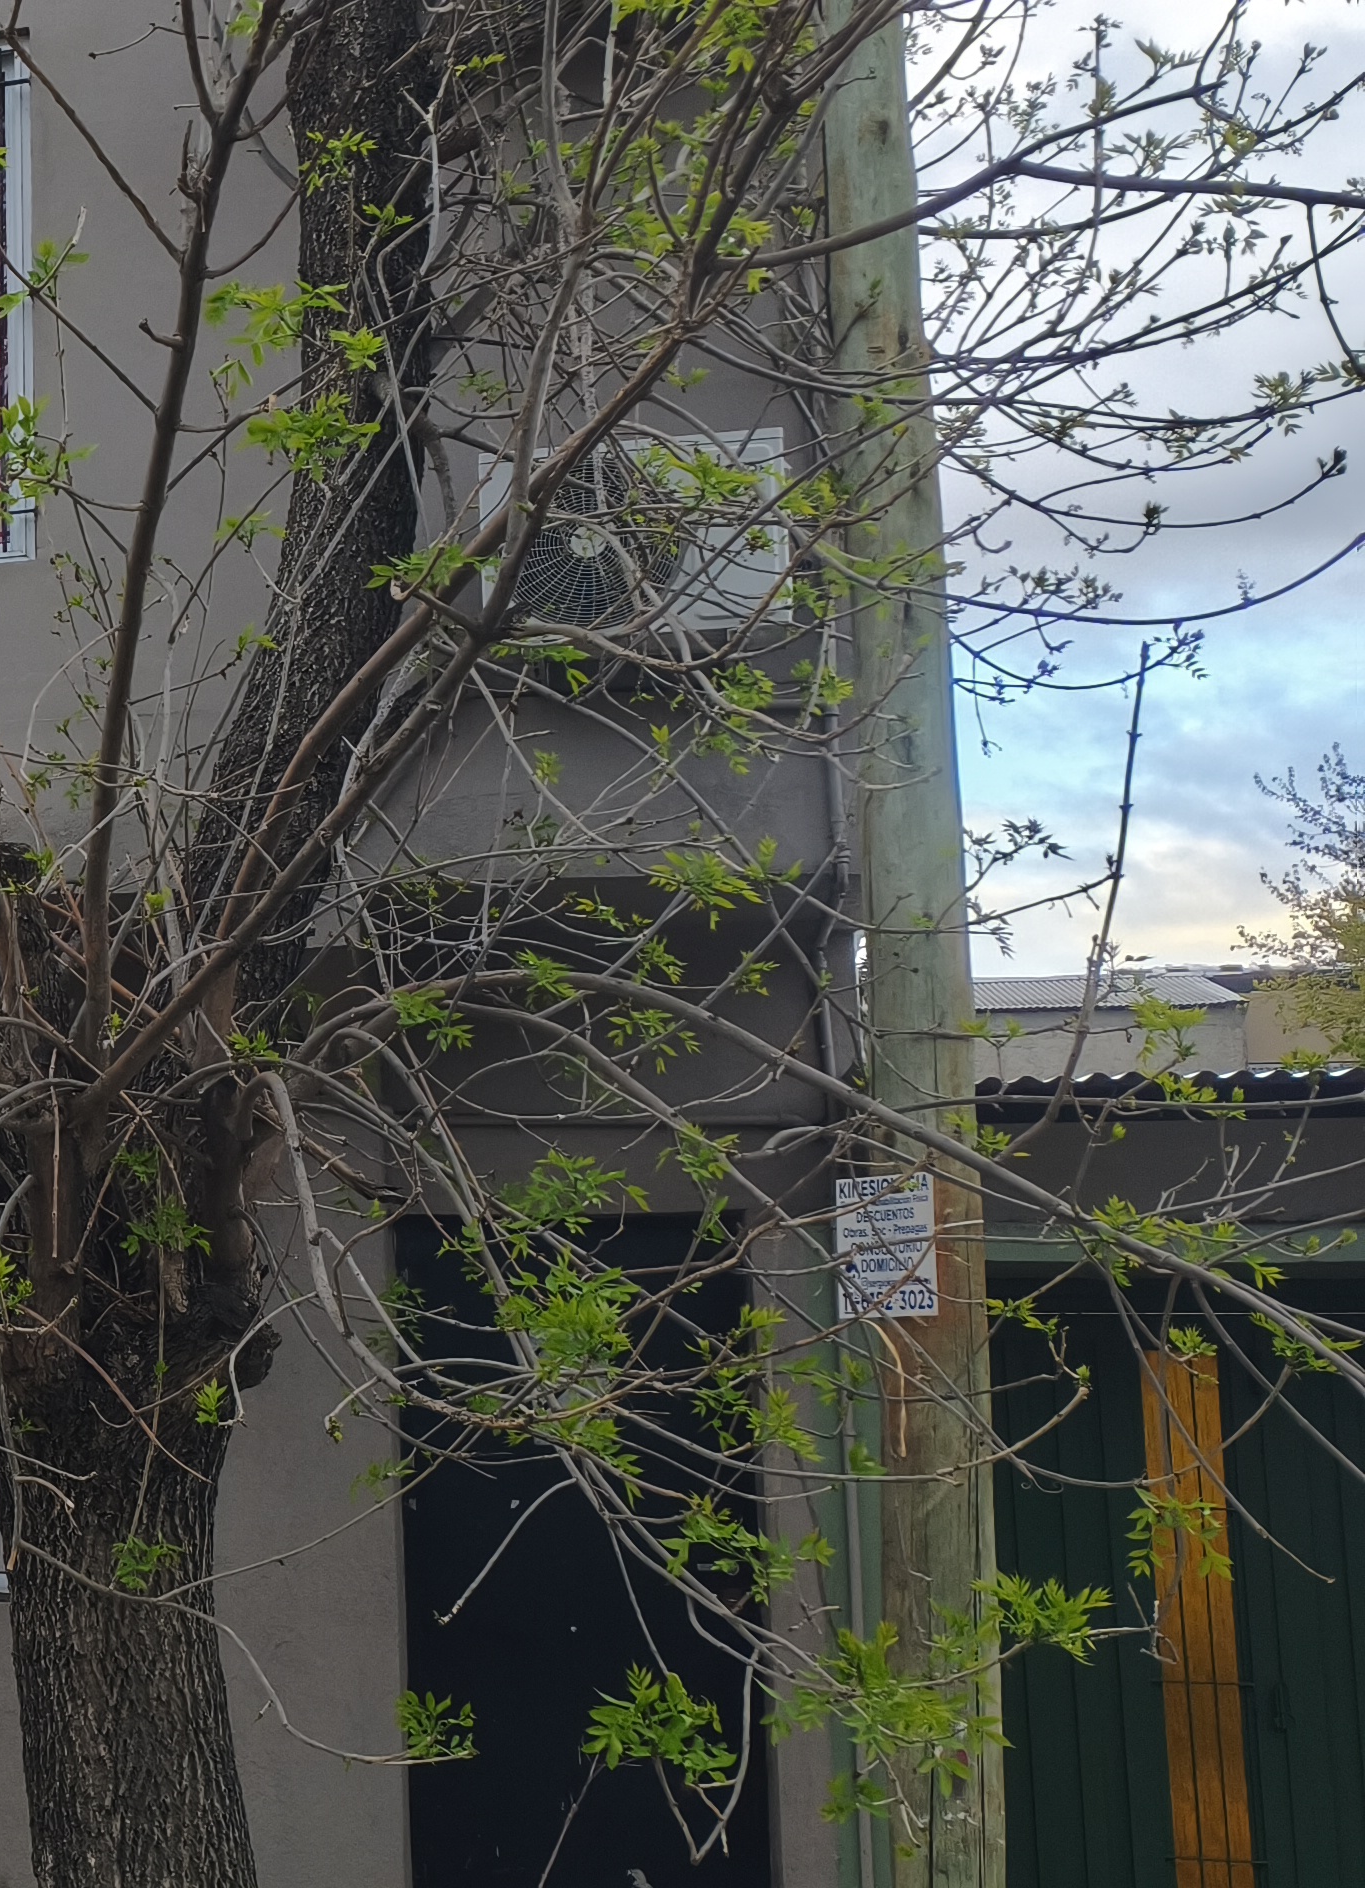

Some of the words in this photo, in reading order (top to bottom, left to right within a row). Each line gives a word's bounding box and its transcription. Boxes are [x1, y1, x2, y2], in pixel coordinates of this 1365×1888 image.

[838, 1174, 929, 1199] KINESIOIA
[856, 1207, 915, 1223] DESCUENTOS
[861, 1256, 914, 1272] DOMICILIO
